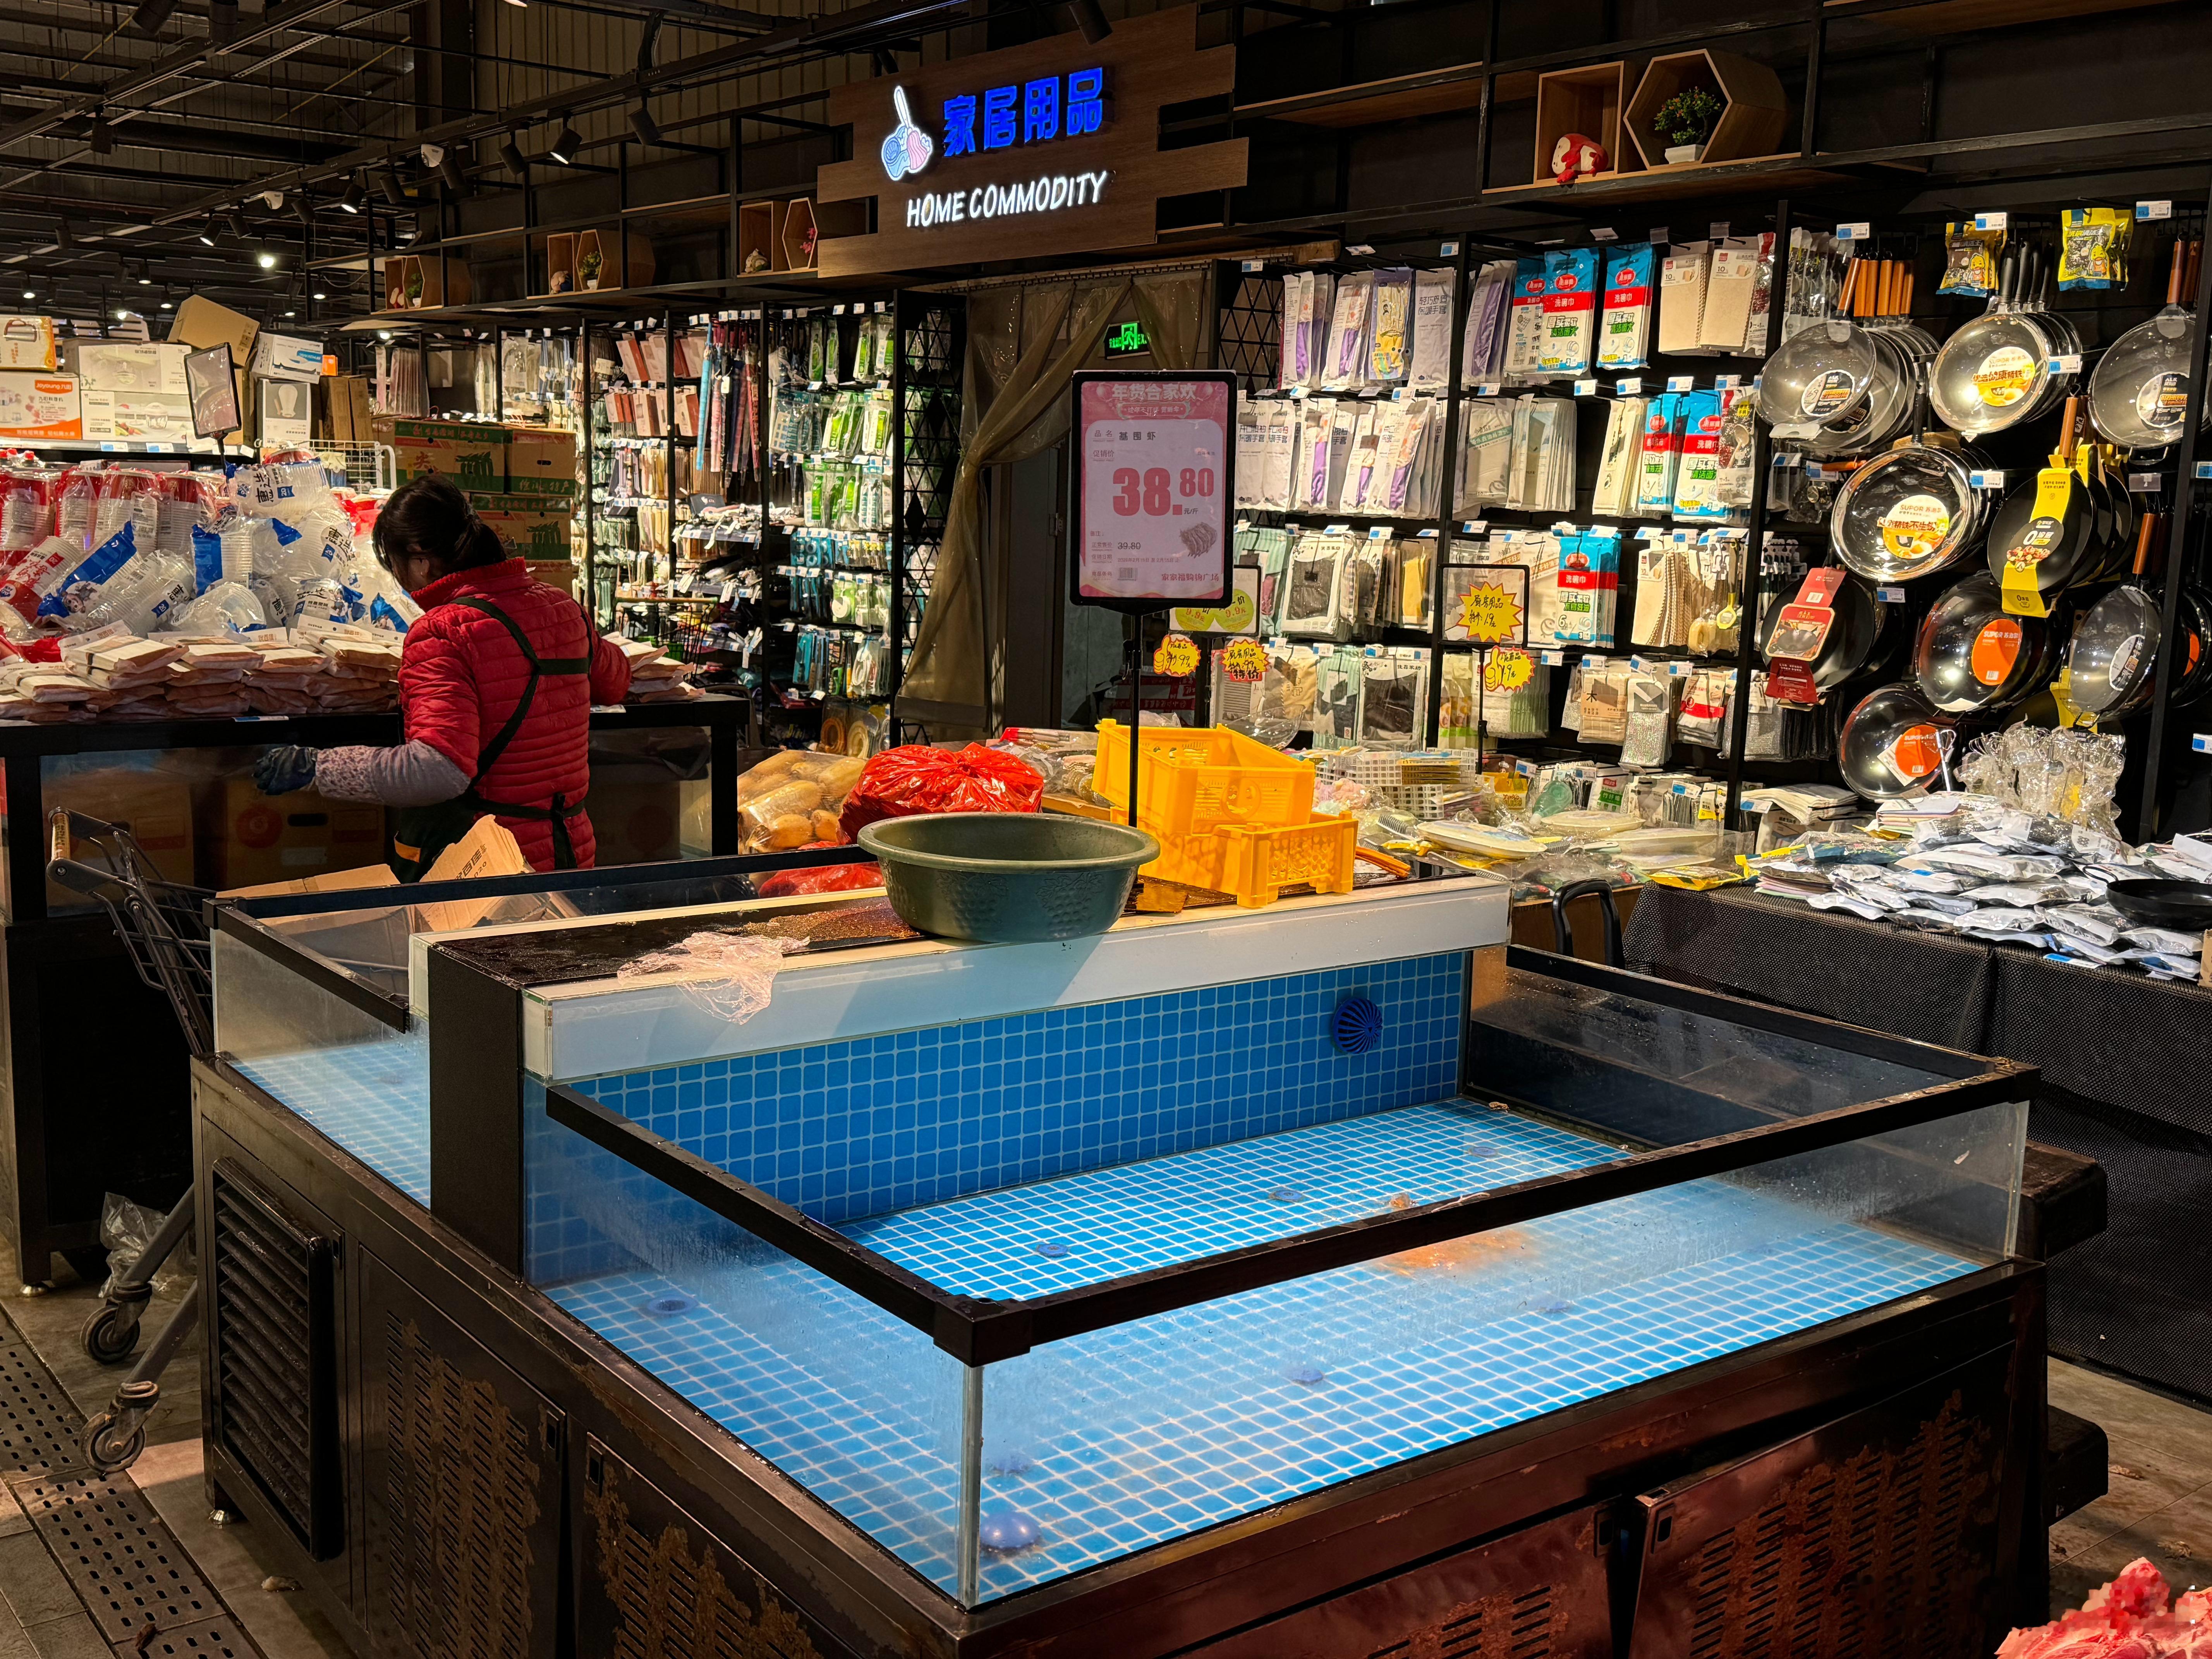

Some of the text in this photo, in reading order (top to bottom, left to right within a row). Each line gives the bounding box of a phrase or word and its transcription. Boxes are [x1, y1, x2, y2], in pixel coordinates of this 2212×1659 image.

[943, 67, 1103, 157] 家居用品
[907, 170, 1108, 228] HOME COMMODITY
[1555, 298, 1574, 307] 洗碗巾
[1614, 293, 1633, 303] 洗碗巾
[1112, 383, 1197, 401] 年货合家欢
[1119, 431, 1156, 441] 基围虾
[1093, 450, 1114, 458] 促销价
[282, 488, 287, 496] 20
[1566, 575, 1586, 584] 洗碗巾
[1470, 595, 1504, 610] 厨房用品
[1233, 670, 1260, 680] 特价
[1586, 691, 1597, 702] 木
